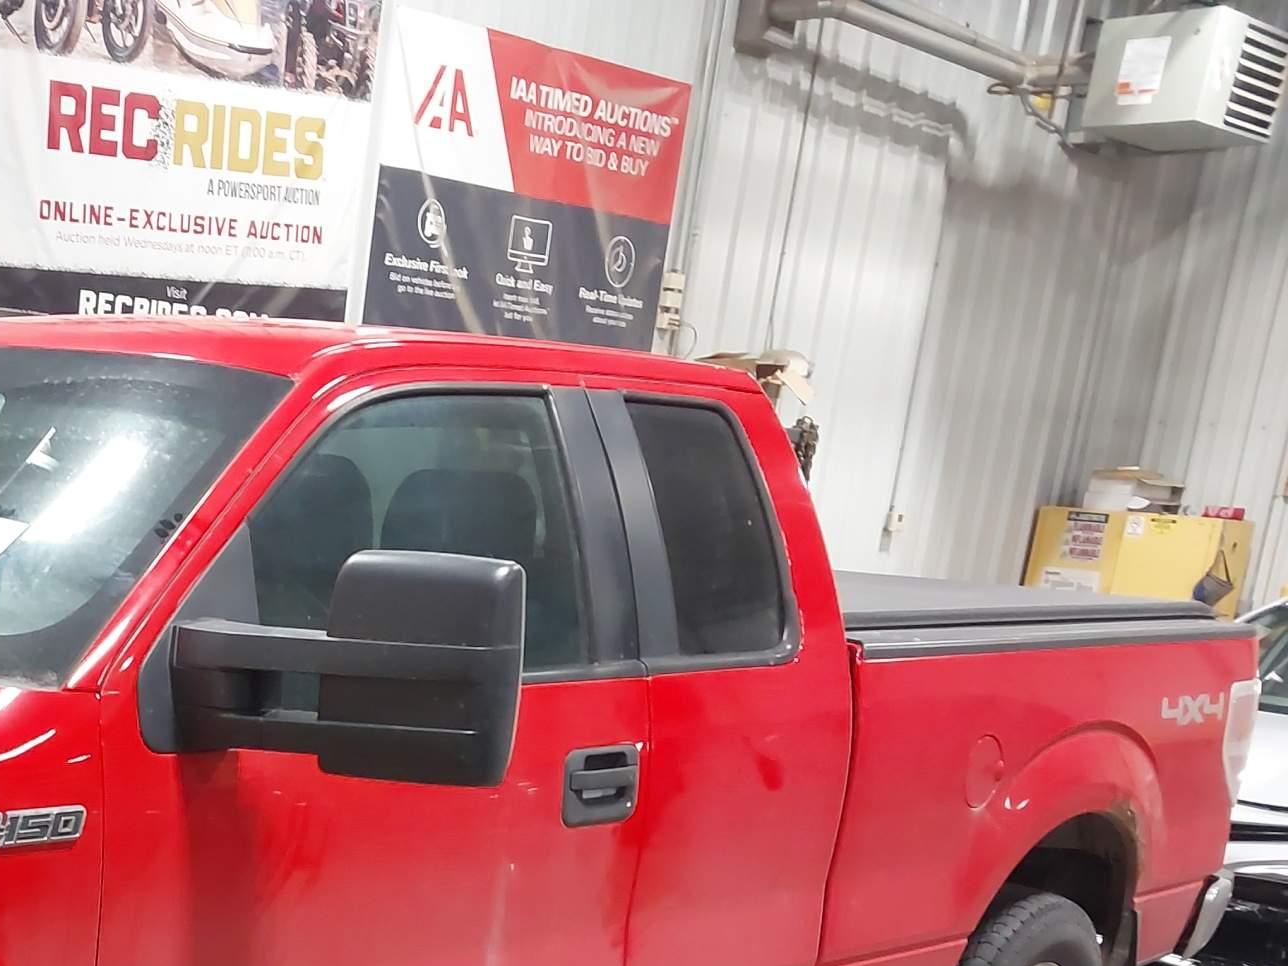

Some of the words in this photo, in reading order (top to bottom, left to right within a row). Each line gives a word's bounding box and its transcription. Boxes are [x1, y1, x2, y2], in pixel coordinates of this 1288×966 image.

[509, 76, 537, 106] IAA
[538, 84, 593, 118] TIMED
[47, 79, 162, 162] REC
[173, 98, 326, 181] RIDES
[524, 109, 616, 148] INTRODUCING
[616, 131, 627, 151] A
[629, 134, 661, 157] NEW
[529, 133, 562, 158] WAY
[564, 140, 585, 163] TO
[585, 146, 607, 168] BID
[607, 151, 619, 172] &
[620, 155, 650, 177] BUY
[207, 178, 215, 196] A
[217, 179, 283, 203] POWERSPORT
[284, 187, 321, 207] AUCTION
[39, 199, 238, 238] ONLINE-EXCLUSIVE
[247, 220, 323, 245] AUCTION
[55, 231, 96, 246] Auction
[98, 234, 121, 248] held
[123, 236, 183, 254] Wednesdays
[198, 244, 223, 256] noon
[225, 244, 239, 256] ET
[384, 252, 428, 272] Exclusive
[450, 265, 469, 280] ook
[165, 285, 188, 301] Visit
[496, 272, 515, 289] Quick
[516, 278, 532, 291] and
[533, 279, 553, 296] Easy
[579, 287, 617, 305] Real-Time
